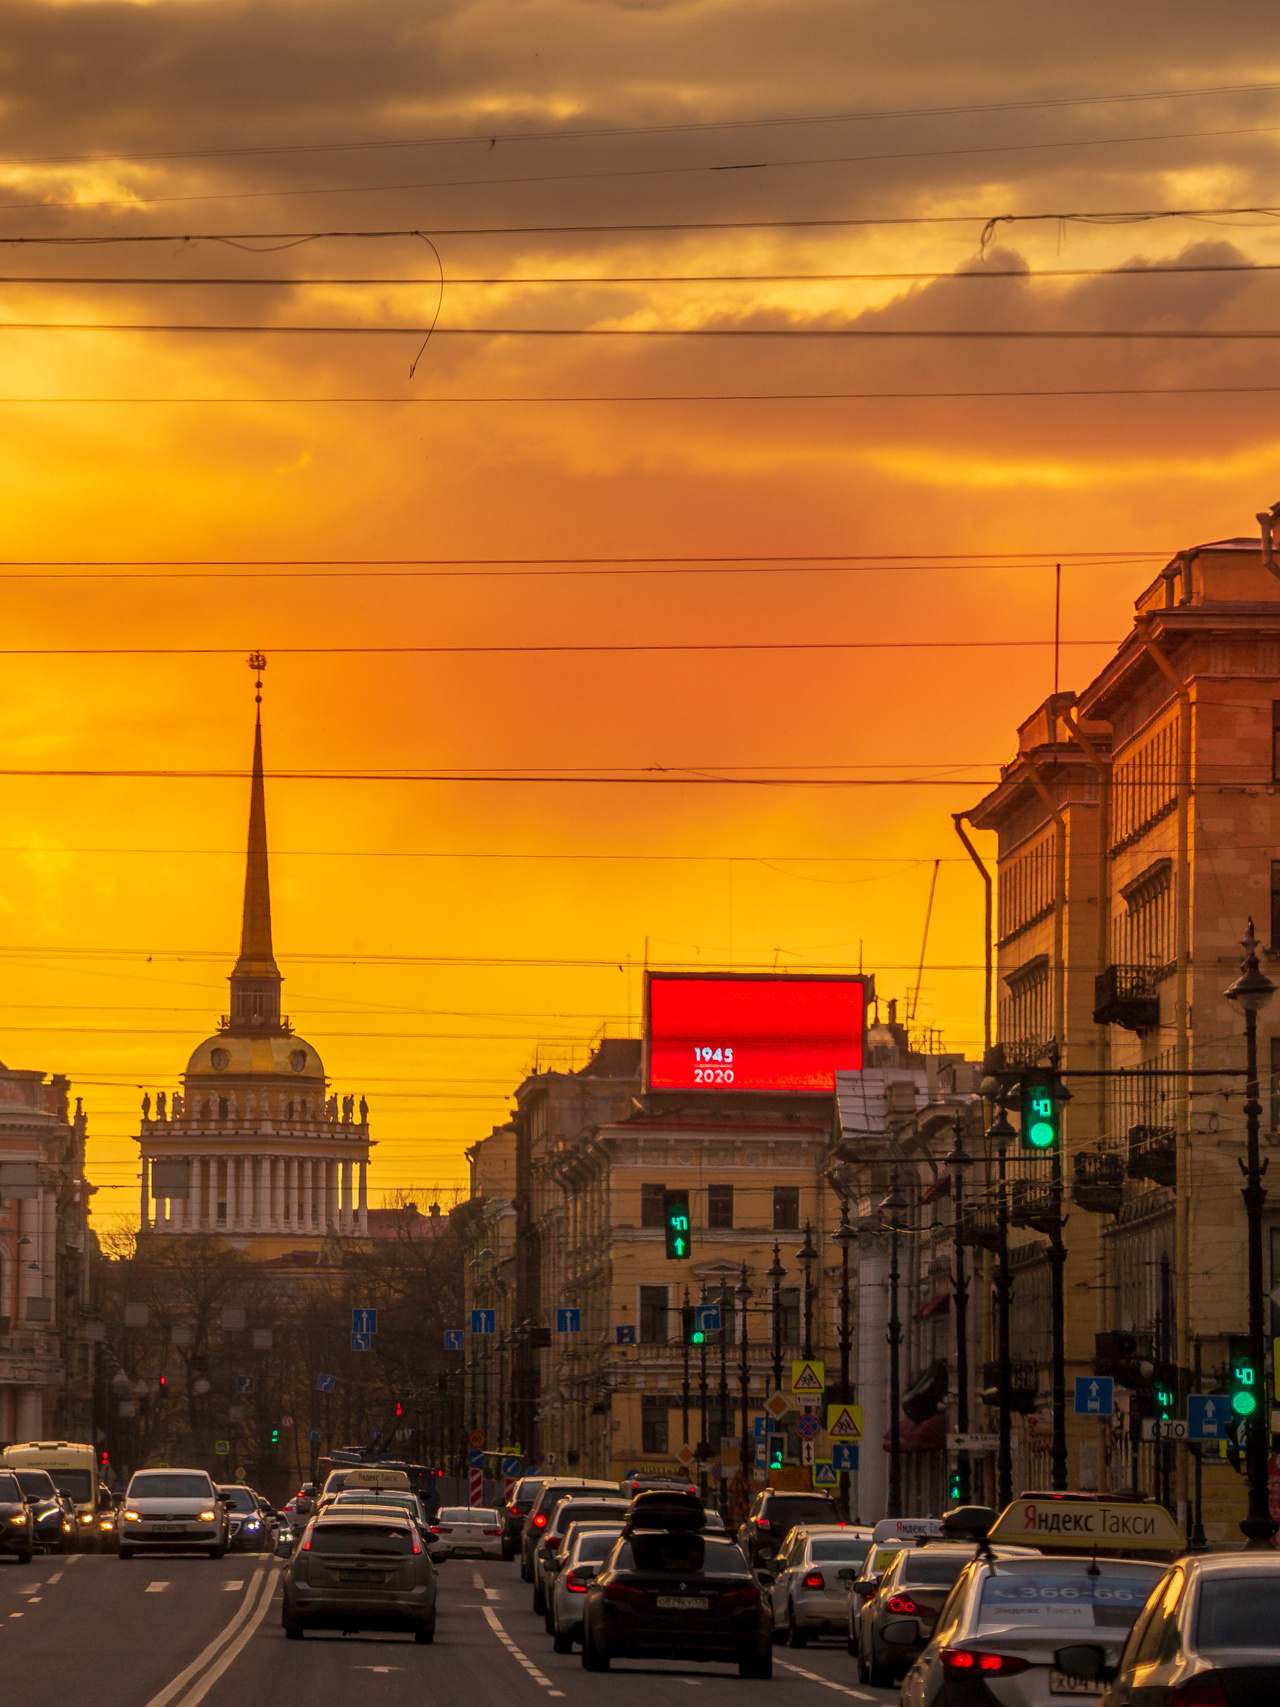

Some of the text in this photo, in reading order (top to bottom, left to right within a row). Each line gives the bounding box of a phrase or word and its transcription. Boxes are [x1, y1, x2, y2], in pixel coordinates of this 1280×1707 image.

[694, 1046, 733, 1063] 1945
[693, 1069, 734, 1083] 2020
[1032, 1098, 1052, 1117] 40
[671, 1216, 688, 1231] 47
[1235, 1368, 1254, 1385] 40
[1158, 1391, 1173, 1406] 41
[1151, 1423, 1185, 1437] СТО
[358, 1472, 398, 1482] Яндекс Такси
[1024, 1504, 1155, 1535] Яндекс Такси
[896, 1521, 927, 1534] Яндекс
[1021, 1587, 1146, 1601] 366-66-
